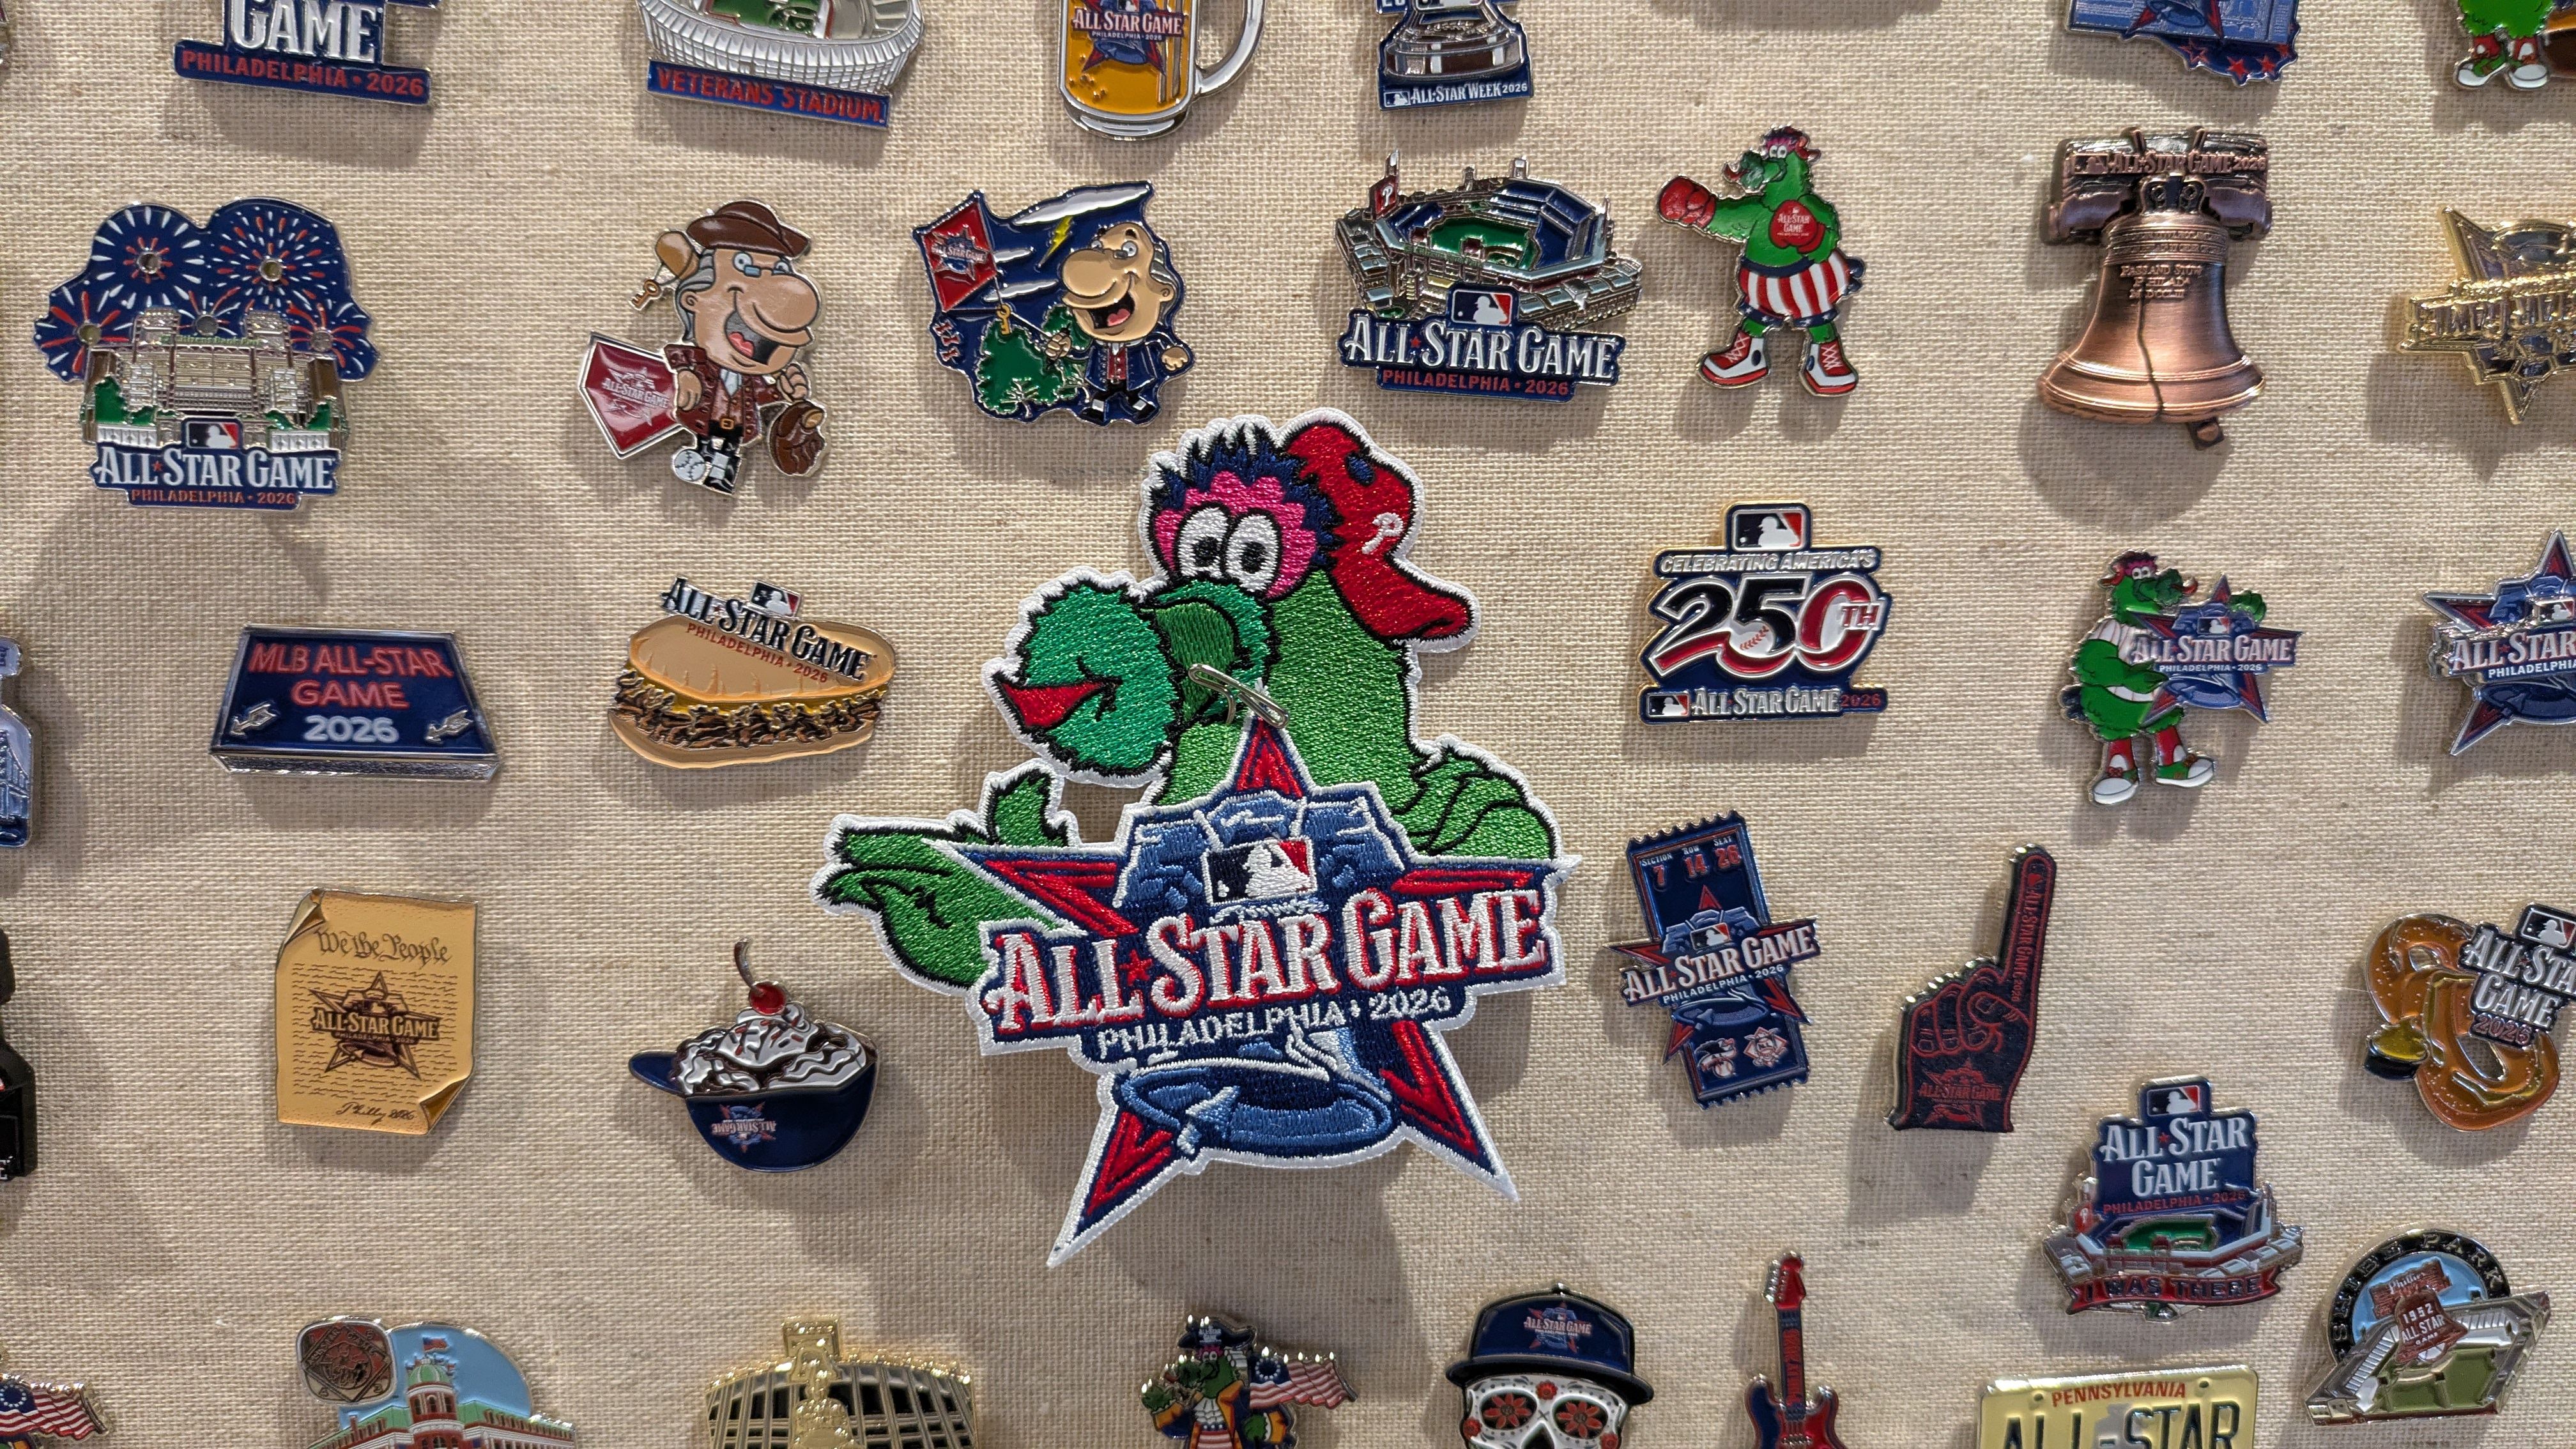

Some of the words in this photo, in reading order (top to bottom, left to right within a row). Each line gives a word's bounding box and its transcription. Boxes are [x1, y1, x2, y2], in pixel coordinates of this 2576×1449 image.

[231, 0, 376, 63] GAME
[1091, 31, 1140, 40] PHILADELPHIA
[1142, 12, 1182, 34] GAME
[182, 50, 348, 88] PHILADELPHIA
[366, 73, 425, 97] 2026
[1465, 82, 1502, 98] WEEK
[1502, 83, 1528, 95] 2026
[657, 66, 773, 106] VETERANS
[781, 87, 881, 122] STADIUM
[1343, 315, 1414, 365] ALL
[1421, 320, 1510, 372] STAR
[1517, 326, 1616, 379] GAME
[1382, 369, 1510, 392] PHILADELPHIA
[1524, 379, 1569, 396] 2026
[93, 446, 158, 485] ALL
[162, 448, 243, 486] STAR
[247, 449, 336, 489] GAME
[131, 489, 245, 504] PHILADELPHIA
[257, 492, 295, 505] 2026
[1660, 553, 1779, 573] CELEBRATING
[1781, 549, 1878, 569] AMERICA'S
[248, 642, 312, 674] MLB
[313, 645, 455, 678] ALL-STAR
[686, 622, 785, 668] PHILADELPHIA
[793, 662, 829, 683] 2026
[792, 624, 872, 682] GAME
[2234, 634, 2295, 661] GAME
[290, 678, 411, 710] GAME
[1785, 689, 1841, 714] GAME
[1841, 693, 1882, 708] 2026
[303, 714, 400, 744] 2026
[1641, 852, 1673, 867] SECTION
[1681, 845, 1700, 855] ROW
[1713, 835, 1733, 847] SEAT
[1652, 864, 1665, 886] 7
[1683, 854, 1708, 878] 14
[1714, 844, 1742, 870] 26
[314, 928, 353, 956] We
[351, 931, 383, 959] the
[379, 933, 453, 970] People
[982, 931, 1148, 1033] ALL
[1146, 912, 1341, 1019] STAR
[1342, 887, 1547, 992] GAME
[1623, 965, 1677, 1002] ALL
[1674, 947, 1745, 988] STAR
[1740, 925, 1815, 970] GAME
[2462, 928, 2521, 979] ALL
[2523, 944, 2576, 998] STA
[1662, 976, 1748, 1004] PHILADELPHIA
[1754, 963, 1784, 979] 2026
[2474, 972, 2560, 1029] GAME
[392, 1015, 438, 1038] GAME
[1097, 999, 1346, 1060] PHILADELPHIA
[1368, 986, 1452, 1021] 2026
[2473, 1015, 2533, 1045] 2026
[2099, 1124, 2163, 1162] ALL
[2168, 1116, 2248, 1156] STAR
[2131, 1158, 2220, 1197] GAME
[2102, 1196, 2203, 1215] PHILADELPHIA
[2212, 1192, 2246, 1205] 2026
[2423, 1234, 2503, 1289] PARK
[2103, 1276, 2163, 1298] WAS
[2172, 1273, 2263, 1300] THERE
[1566, 1321, 1592, 1335] GAME
[2401, 1326, 2420, 1344] ALL
[2418, 1314, 2446, 1334] STAR
[2402, 1303, 2434, 1324] 1952
[2051, 1381, 2186, 1407] PENNSYLVANIA
